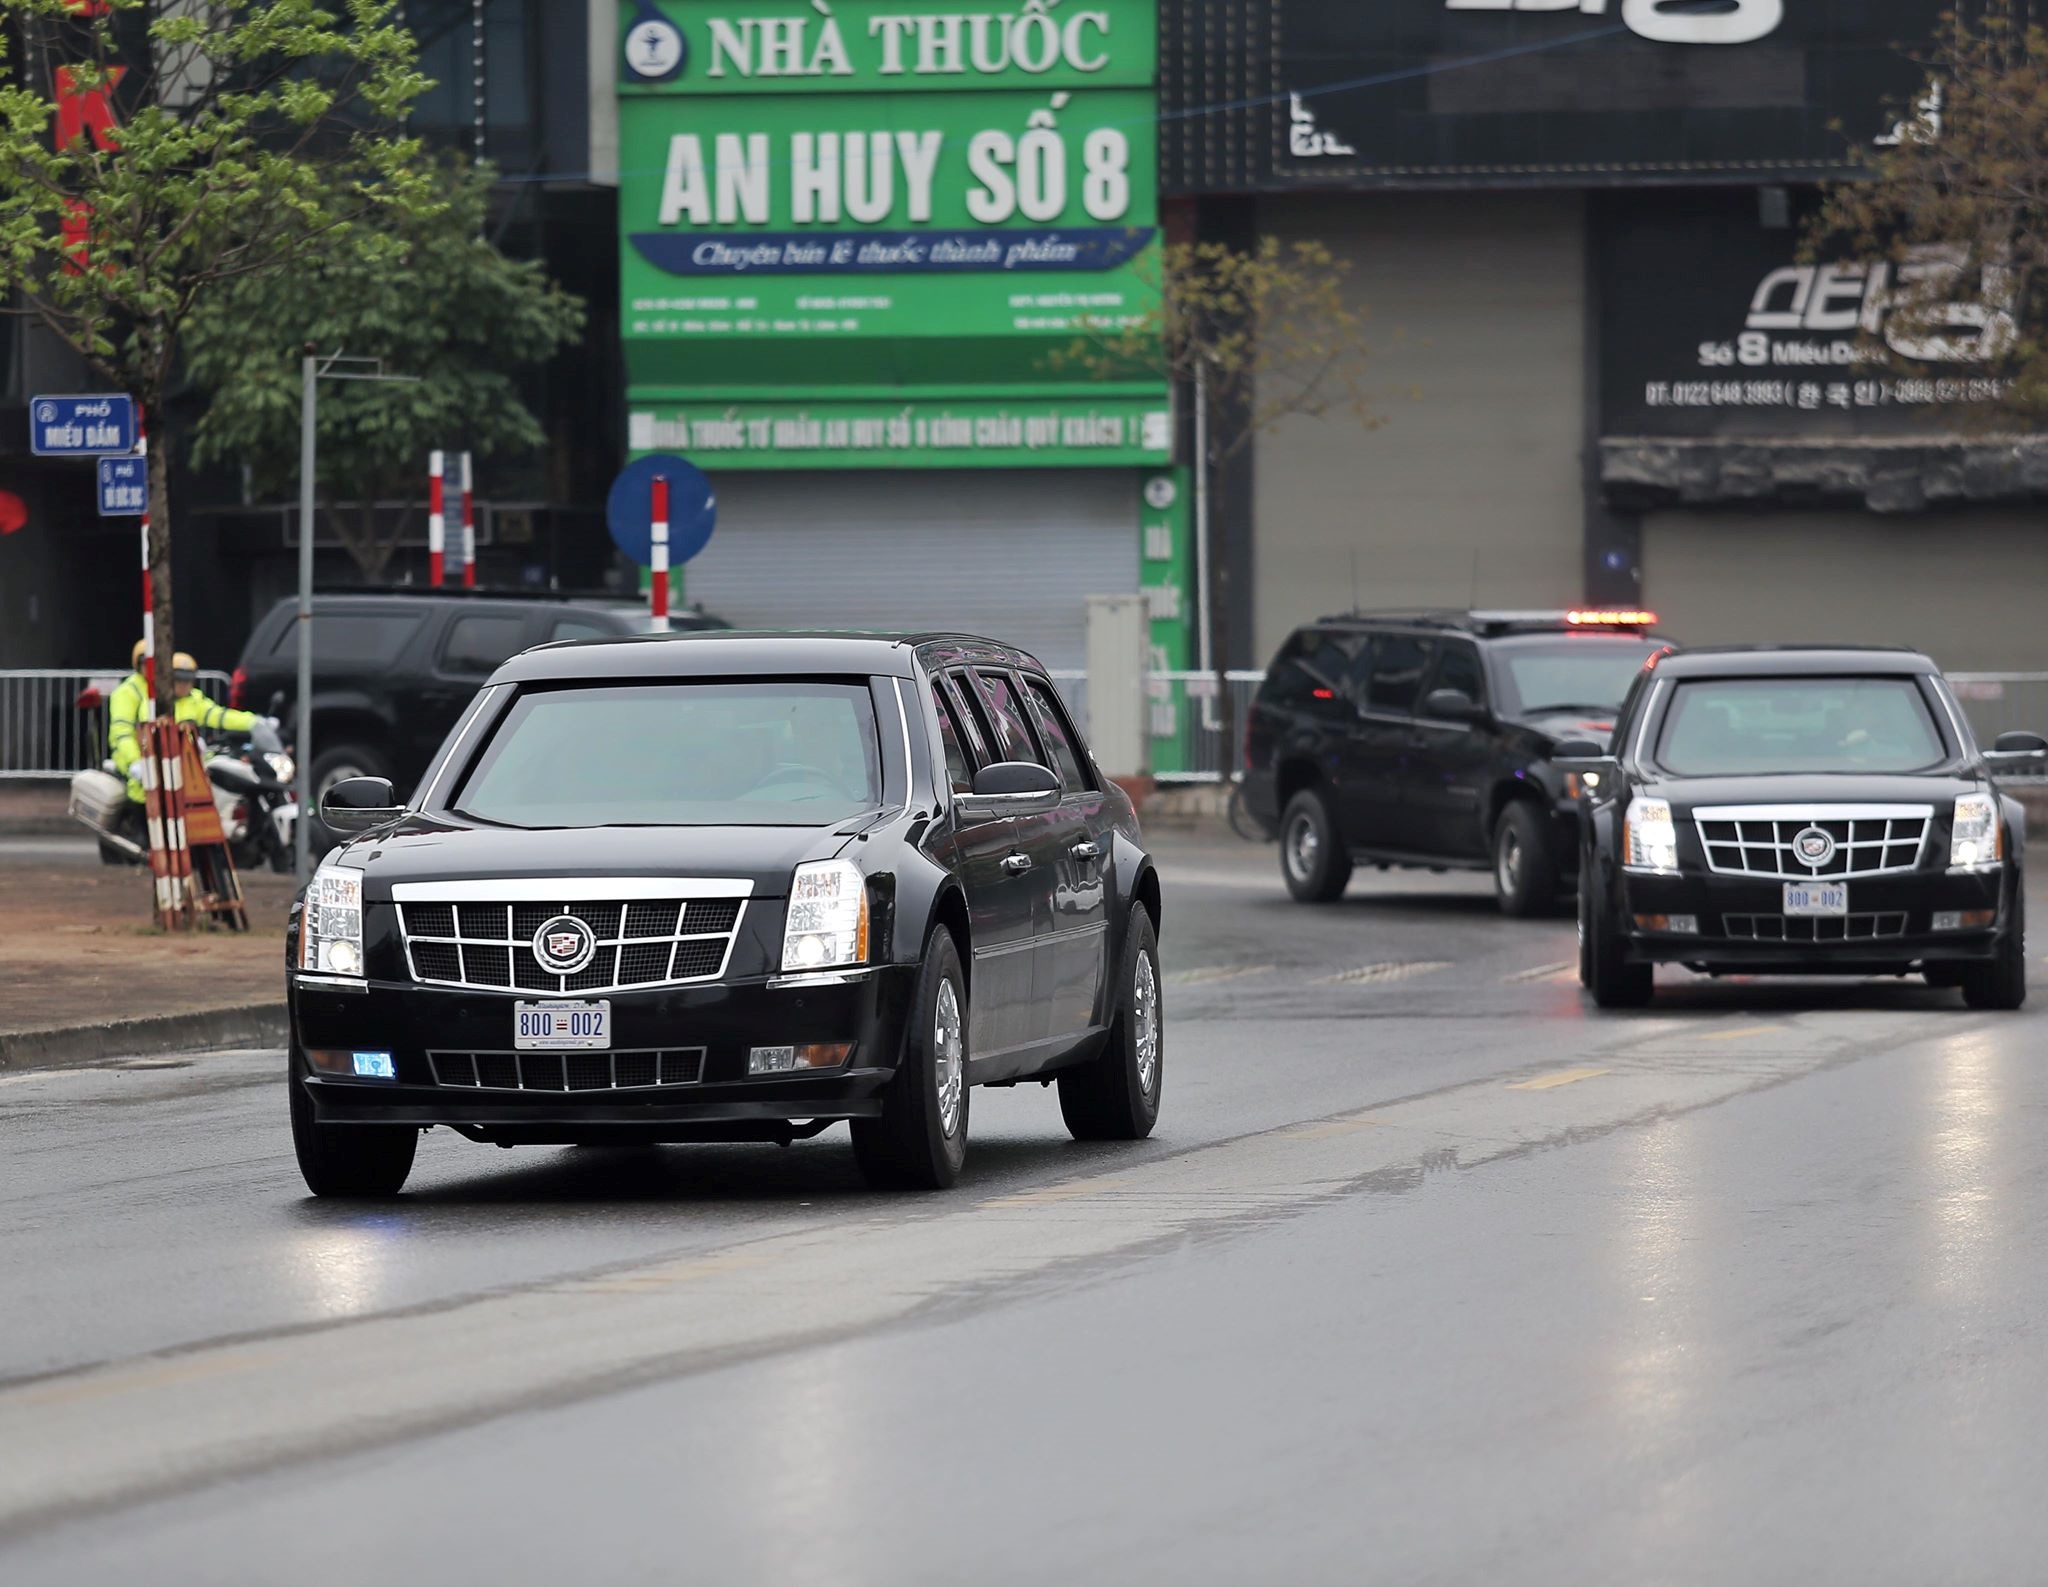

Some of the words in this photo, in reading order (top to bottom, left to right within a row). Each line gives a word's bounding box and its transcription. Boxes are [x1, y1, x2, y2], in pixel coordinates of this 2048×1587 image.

[706, 0, 855, 77] NHÀ
[868, 0, 1110, 74] THUỐC
[659, 133, 770, 225] AN
[792, 130, 943, 224] HUY
[966, 92, 1070, 224] SỐ
[1083, 128, 1129, 222] 8
[692, 241, 781, 270] Chuyên
[857, 237, 926, 265] thuốc
[929, 237, 1001, 263] thành
[1003, 234, 1077, 269] phẩm
[1737, 331, 1769, 366] 8
[75, 399, 112, 418] PHỐ
[520, 1012, 552, 1036] 800
[571, 1012, 603, 1036] 002
